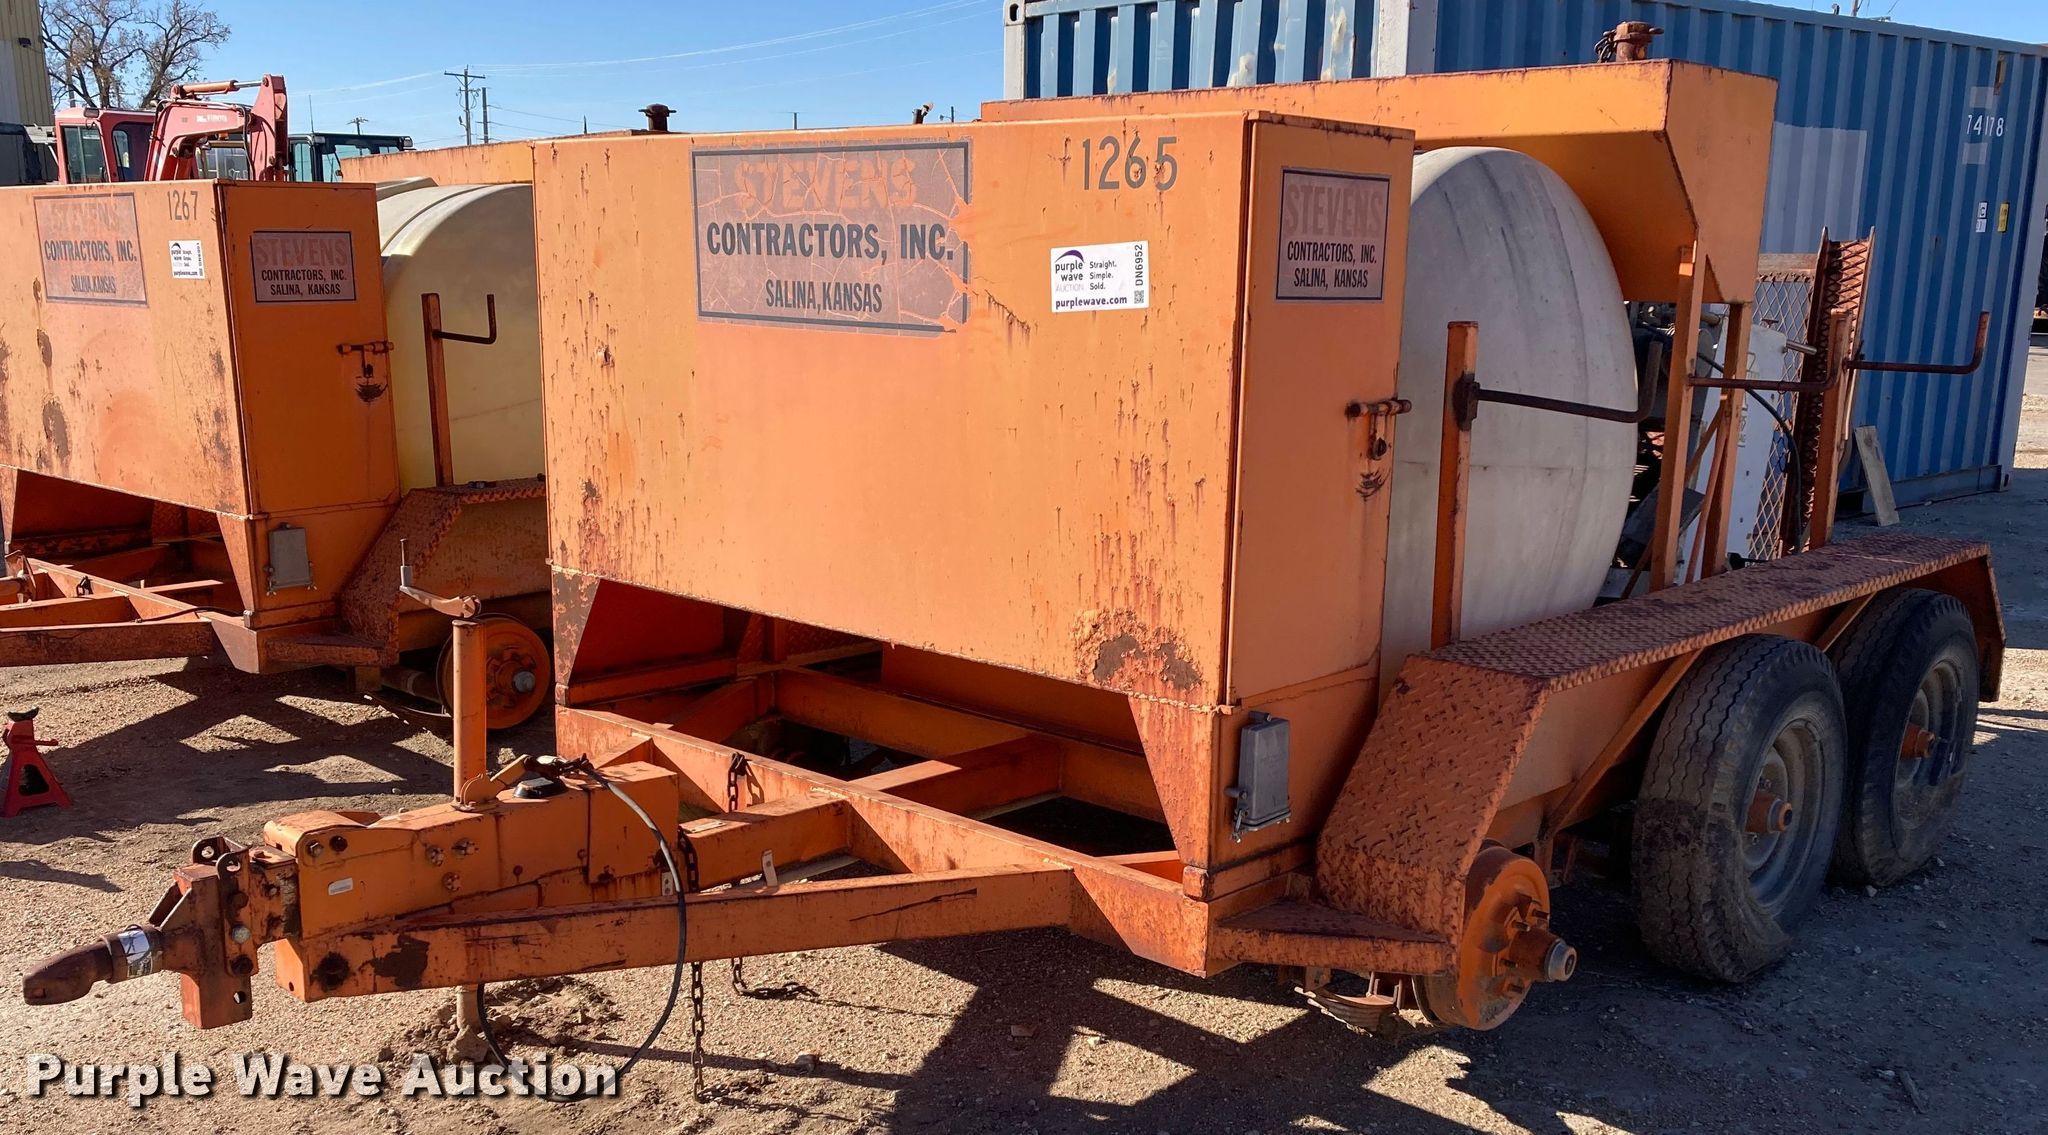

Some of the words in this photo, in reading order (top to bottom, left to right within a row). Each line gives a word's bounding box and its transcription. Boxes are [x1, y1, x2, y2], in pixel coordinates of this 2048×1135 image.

[1966, 114, 2005, 137] 74178
[1082, 135, 1178, 191] 1265
[734, 158, 917, 209] STEVENS
[167, 190, 199, 221] 1267
[1284, 184, 1384, 238] STEVENS
[44, 239, 115, 264] CONTRACTORS,
[116, 240, 138, 262] INC.
[256, 238, 347, 266] STEVENS
[707, 221, 888, 265] CONTRACTORS,
[900, 223, 954, 260] INC.
[1287, 241, 1356, 266] CONTRACTORS,
[1360, 244, 1377, 264] INC.
[261, 269, 326, 281] CONTRACTORS,
[330, 269, 347, 281] INC.
[1055, 260, 1084, 274] purple
[1089, 260, 1118, 270] Straight.
[1089, 271, 1114, 281] Simple.
[1134, 244, 1144, 286] DN6952
[270, 284, 304, 296] SALINA,
[307, 283, 341, 295] KANSAS
[1061, 273, 1084, 282] wave
[1089, 282, 1106, 290] Sold.
[1293, 267, 1329, 291] SALINA,
[1333, 268, 1369, 288] KANSAS
[1055, 296, 1128, 310] purplewave.com
